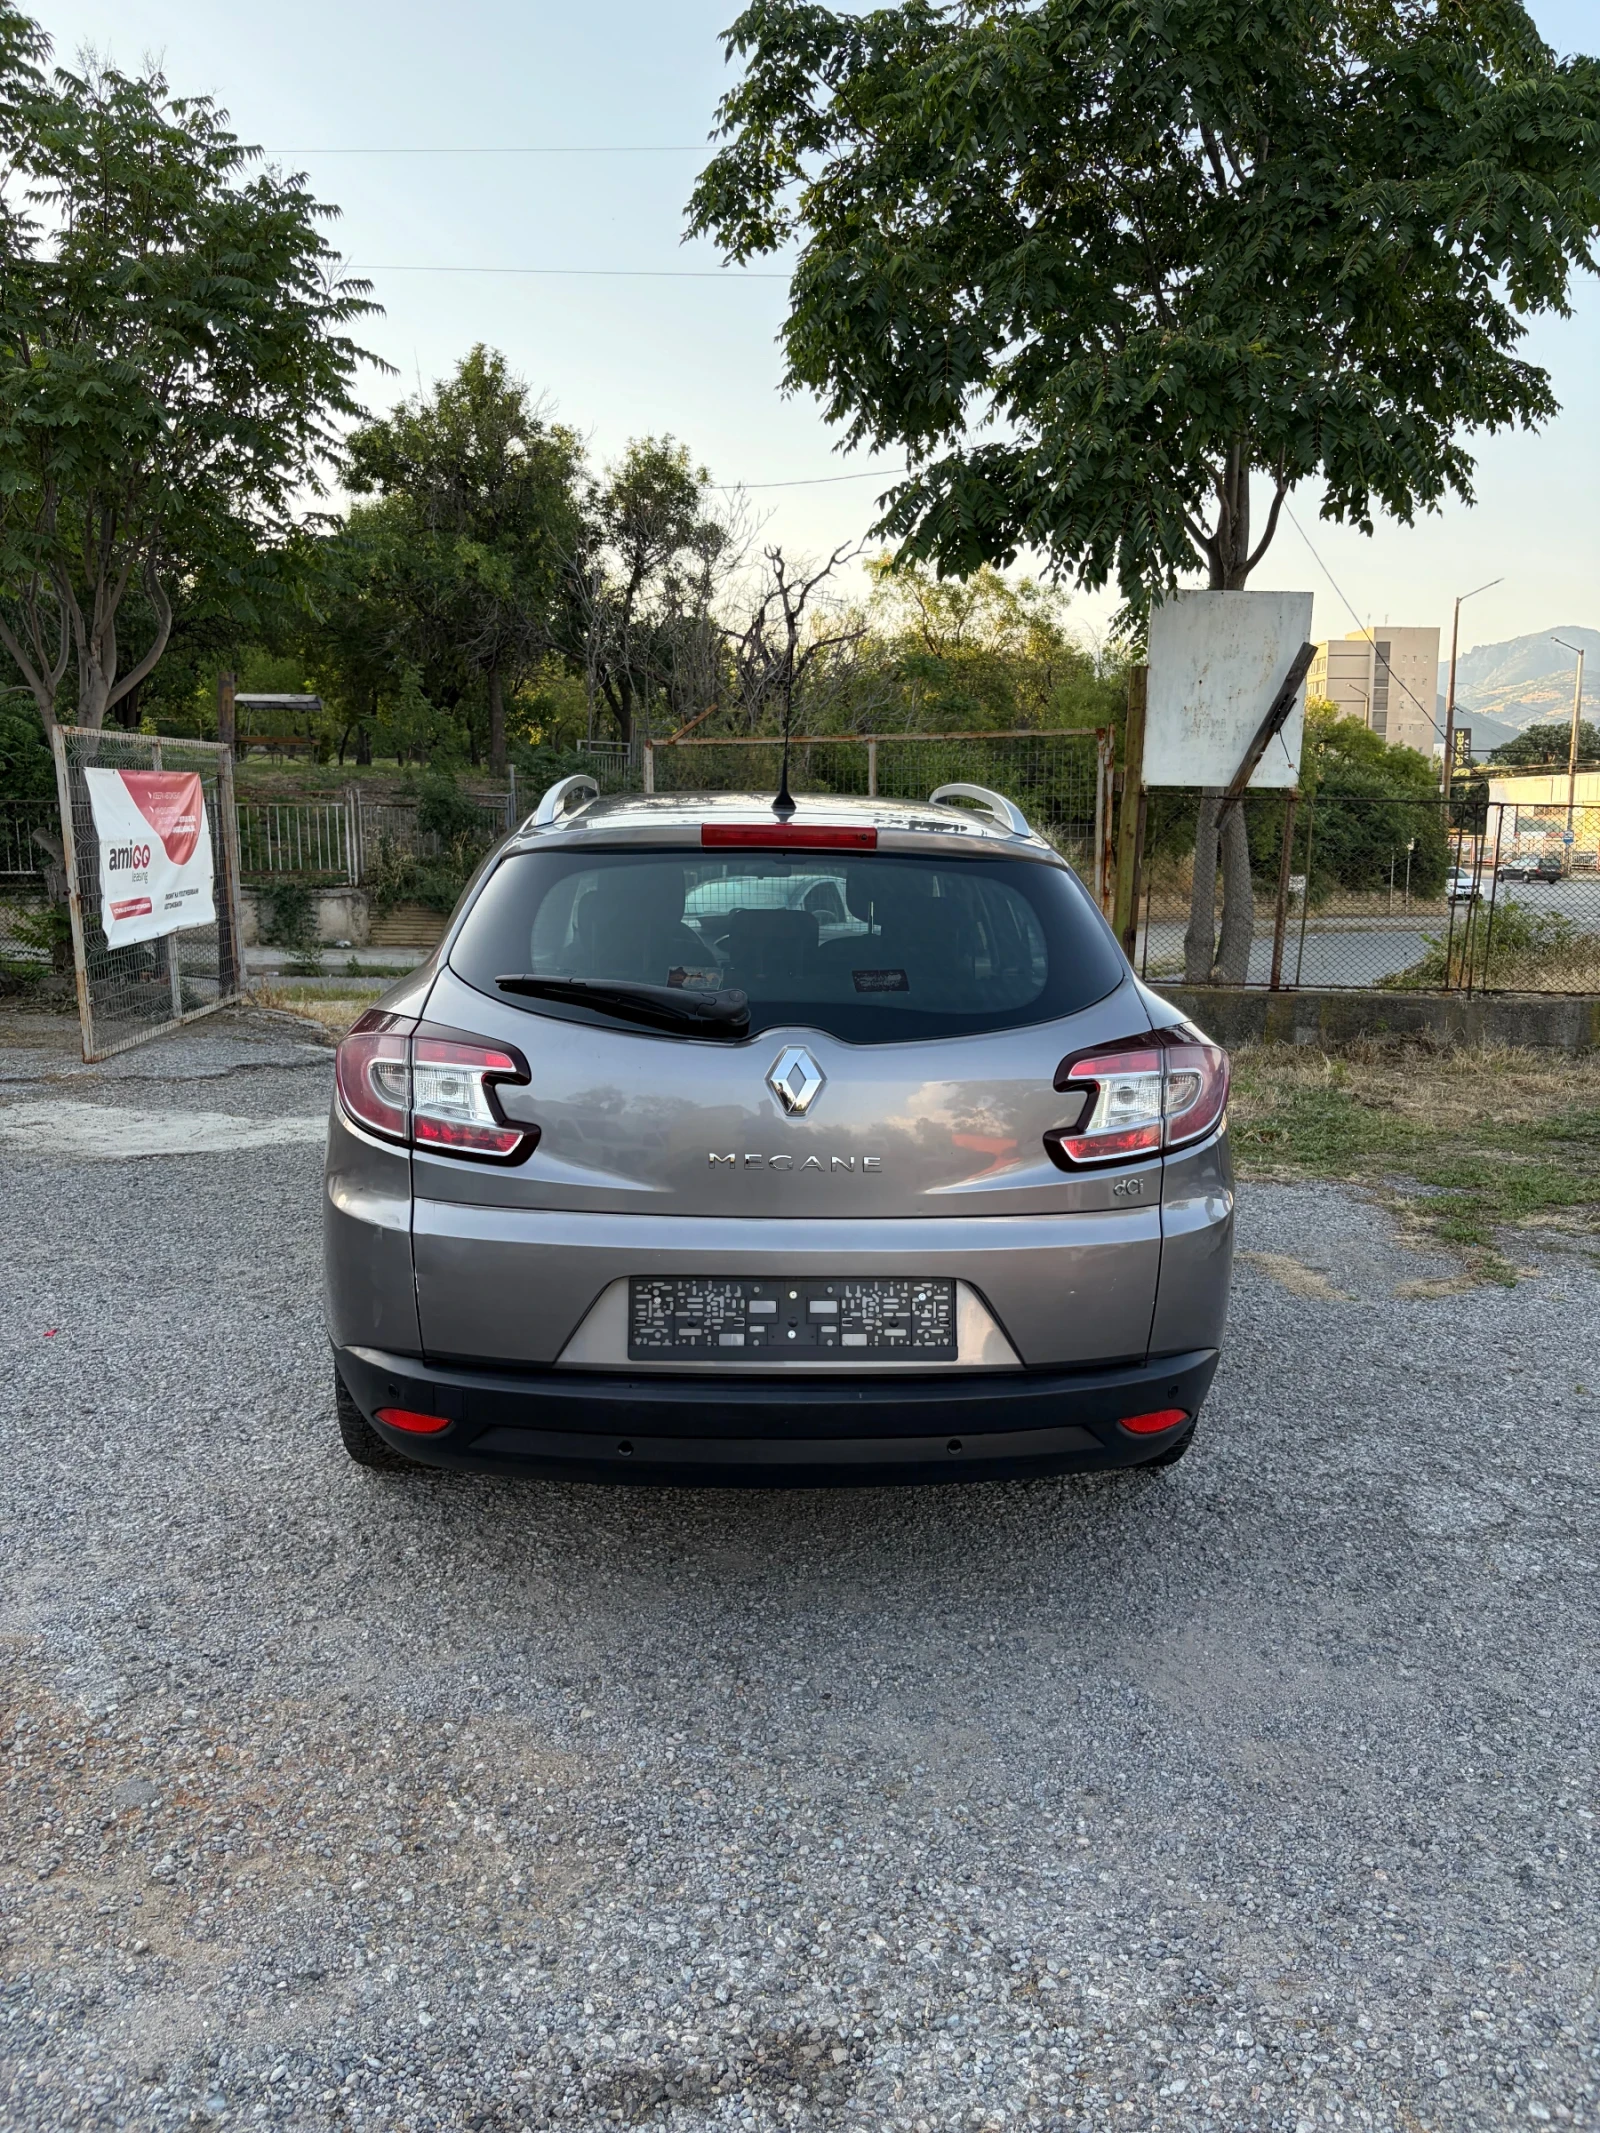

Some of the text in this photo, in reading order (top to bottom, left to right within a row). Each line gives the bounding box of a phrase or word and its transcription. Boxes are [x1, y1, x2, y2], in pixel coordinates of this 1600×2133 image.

[132, 871, 149, 884] leasing
[708, 1152, 883, 1173] MEGANE
[1113, 1178, 1144, 1196] dCi
